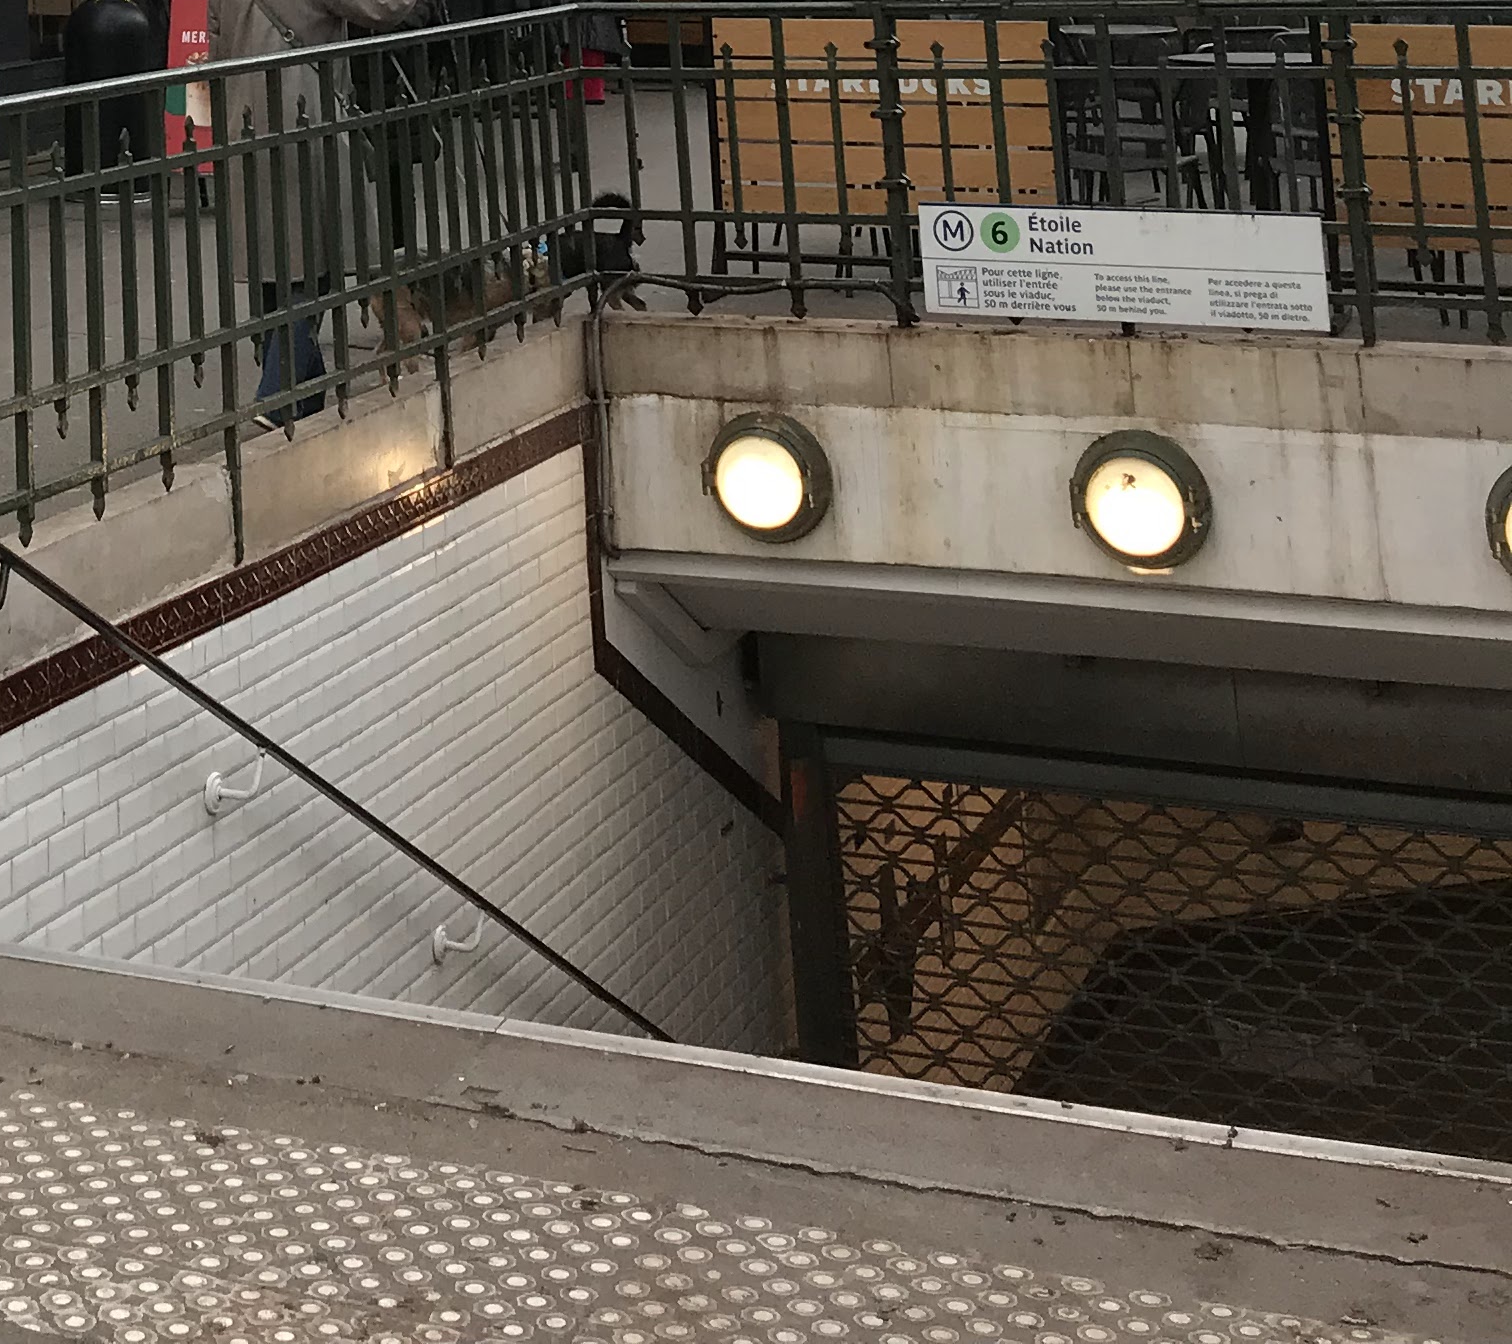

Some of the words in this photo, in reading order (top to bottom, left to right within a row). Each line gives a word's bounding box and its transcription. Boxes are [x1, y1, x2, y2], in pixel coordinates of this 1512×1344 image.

[1028, 213, 1083, 234] Étoile
[990, 220, 1009, 246] 6
[1030, 237, 1094, 256] Nation
[982, 267, 1004, 277] Pour
[1007, 268, 1032, 279] cette
[1093, 273, 1104, 281] To
[1134, 275, 1150, 283] this
[982, 278, 1017, 288] utiliser
[1020, 279, 1058, 290] l'entrée
[1095, 284, 1121, 293] please
[1139, 285, 1153, 294] the
[1155, 287, 1192, 296] entrance
[1208, 278, 1222, 286] Per
[1224, 279, 1262, 288] accedere
[1272, 281, 1301, 290] questa
[984, 290, 1006, 298] sous
[1008, 289, 1017, 299] le
[1020, 290, 1055, 301] viaduc,
[1096, 293, 1120, 302] below
[1122, 295, 1136, 303] the
[1243, 291, 1268, 300] prega
[1269, 291, 1278, 299] di
[984, 300, 996, 308] 50
[999, 301, 1008, 309] m
[1011, 300, 1051, 310] derrière
[1054, 304, 1077, 312] vous
[1096, 304, 1107, 312] 50
[1119, 305, 1147, 314] behind
[1209, 299, 1248, 308] utilizzare
[1290, 303, 1313, 312] sotto
[1258, 312, 1269, 320] 50
